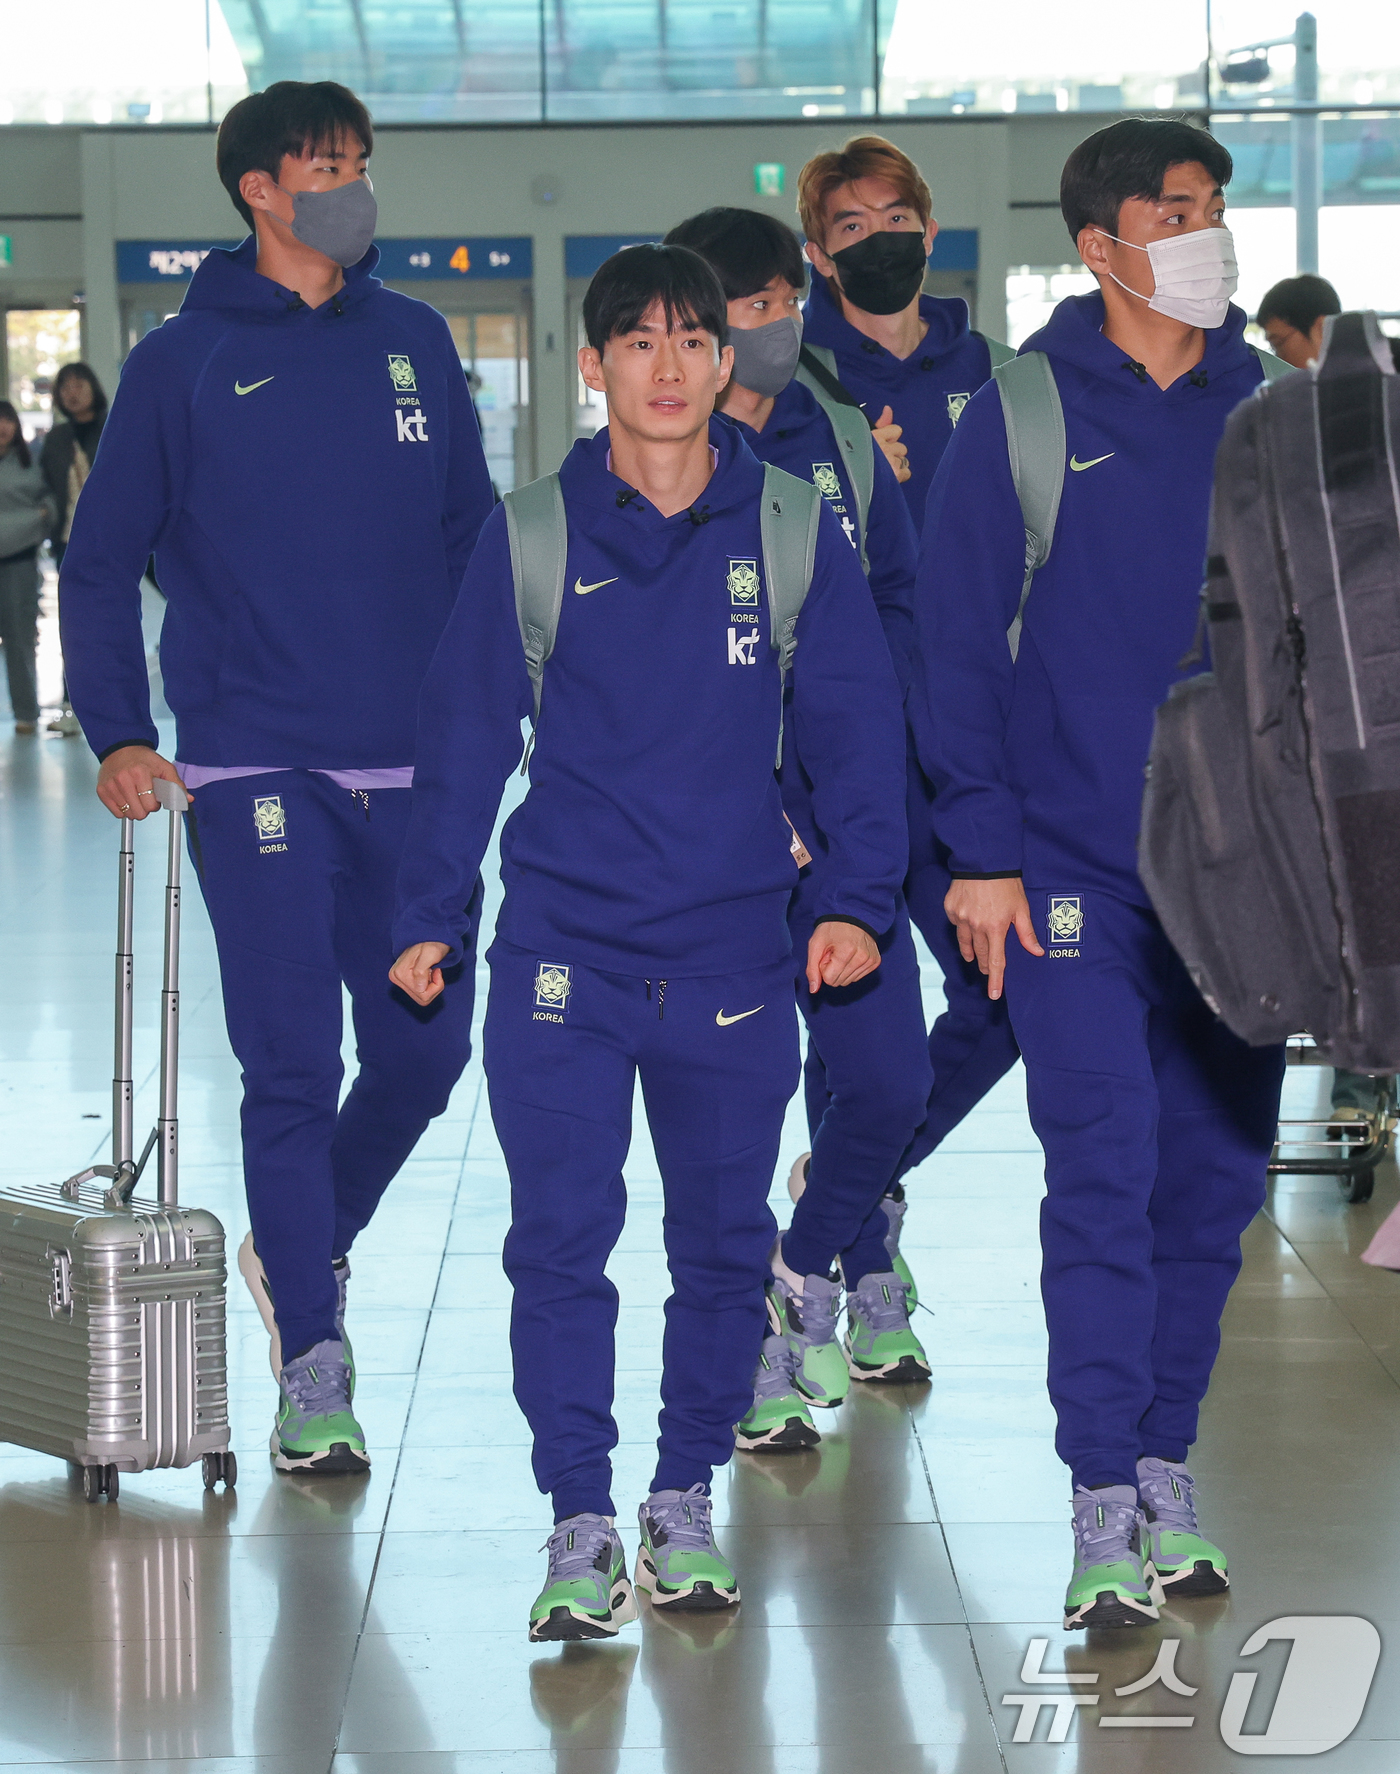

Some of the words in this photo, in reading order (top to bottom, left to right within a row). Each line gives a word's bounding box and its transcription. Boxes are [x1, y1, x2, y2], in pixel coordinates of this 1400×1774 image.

[449, 245, 471, 273] 4
[395, 397, 420, 406] KOREA
[394, 408, 429, 442] kt
[832, 505, 847, 513] REA
[730, 613, 759, 624] KOREA
[727, 627, 760, 665] kt
[259, 843, 288, 855] KOREA
[1049, 948, 1081, 959] KOREA
[532, 1011, 564, 1025] KOREA
